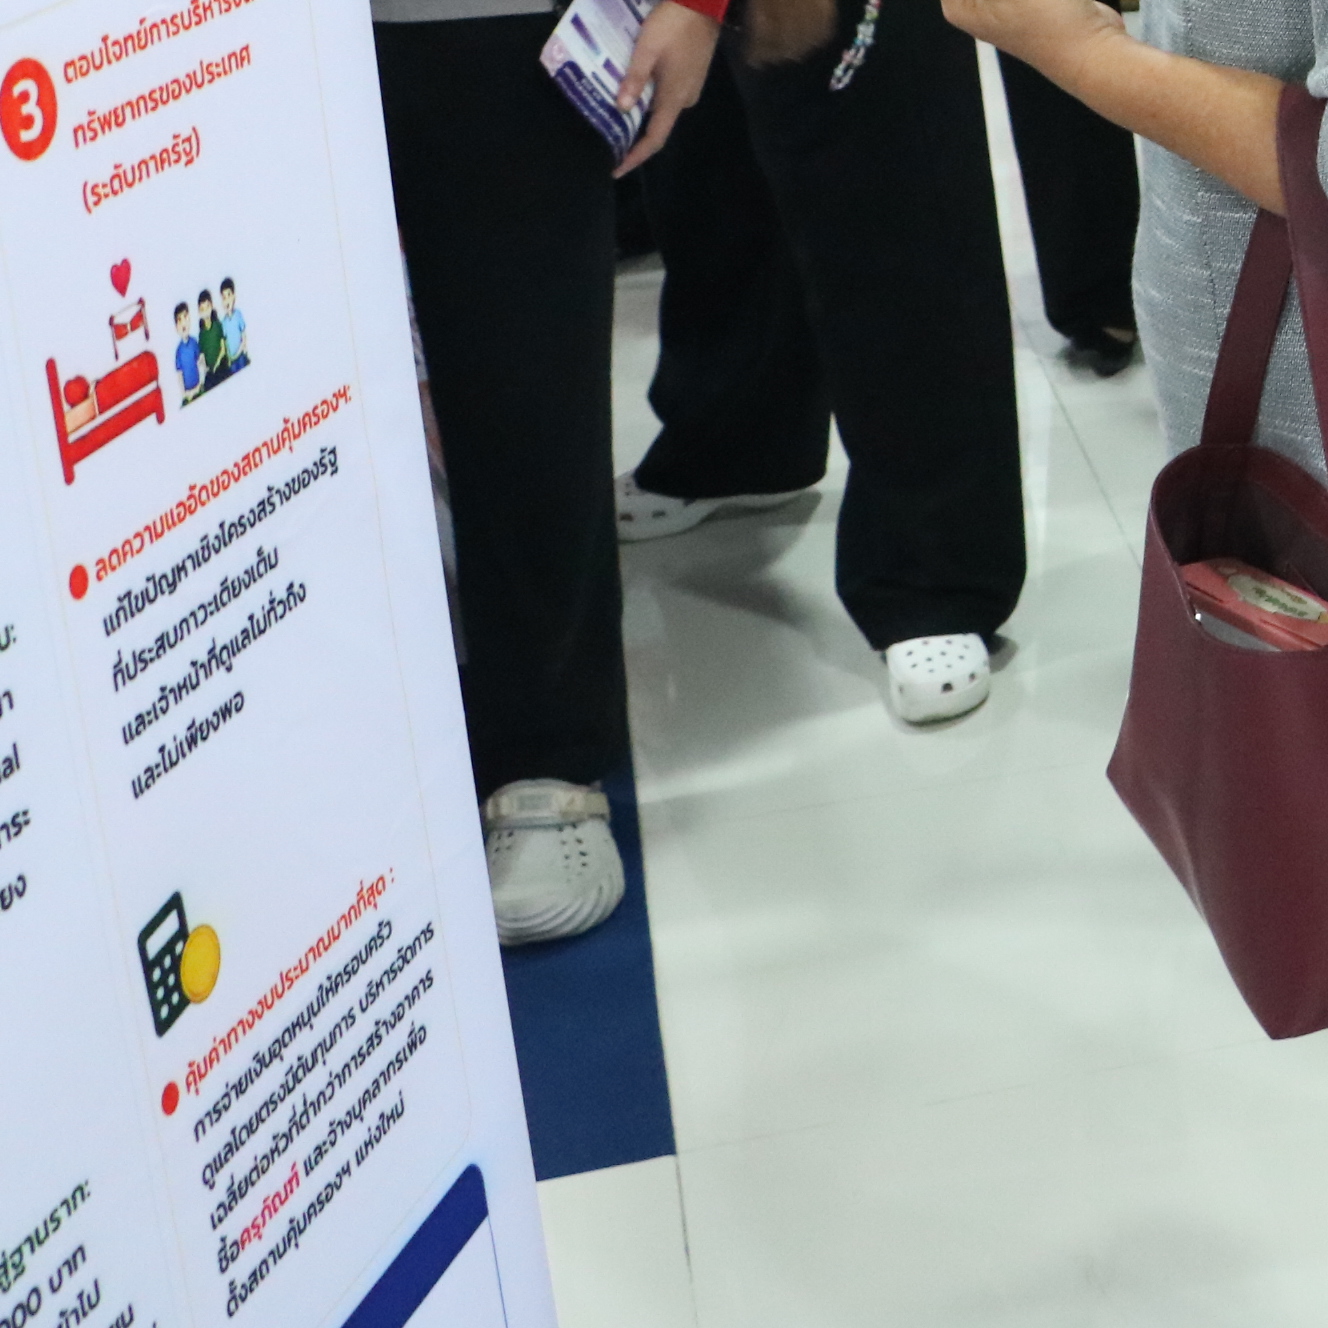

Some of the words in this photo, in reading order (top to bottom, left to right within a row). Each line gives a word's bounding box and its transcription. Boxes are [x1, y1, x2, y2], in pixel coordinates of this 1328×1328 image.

[13, 77, 44, 143] 3
[72, 44, 251, 149] ทรัพยากรของประเทศ
[82, 126, 201, 214] (ระดับภาครัฐ)
[95, 384, 352, 582] ลดความแออัดของสถานคุ้มครองฯ:
[103, 446, 339, 637] แก้ไขปัญหาเชิงโครงสร้างของรัฐ
[112, 545, 280, 692] ที่ประสบภาวะเตียงเต็ม
[121, 580, 307, 745] และเจ้าหน้าที่ดูแลไม่ทั่วถึง
[0, 742, 21, 785] al
[131, 689, 246, 800] และไม่เพียงพอ
[184, 874, 387, 1096] คุ้มค่าทางงบประมาณมากที่สุด
[193, 918, 394, 1143] การจ่ายเงินอุดหนุนให้ครอบครัว
[201, 1007, 357, 1191] ดูแลโดยตรงมีต้นทุนการ
[358, 921, 435, 1014] บริหารจัดการ
[210, 969, 434, 1231] เฉลี่ยต่อหัวที่ต่ำกว่าการสร้างอาคาร
[302, 1021, 428, 1178] และจ้างบุคลากรเพื่อ
[48, 1244, 87, 1294] บาท
[226, 1160, 352, 1319] ตั้งสถานคุ้มครองฯ
[354, 1089, 406, 1168] แห่งใหม่
